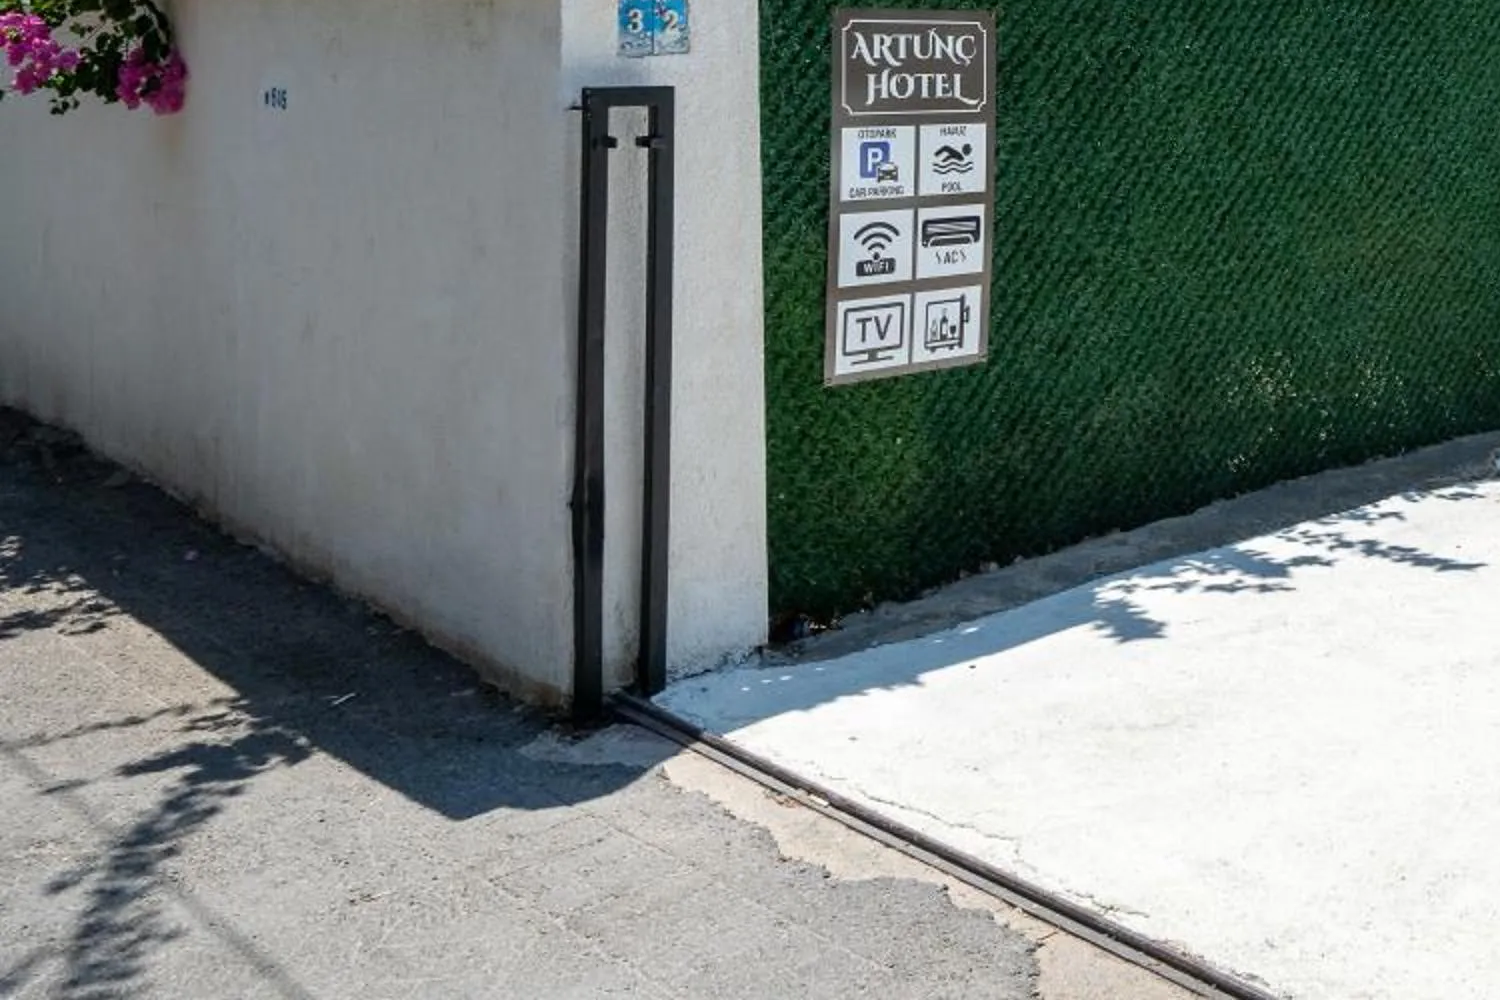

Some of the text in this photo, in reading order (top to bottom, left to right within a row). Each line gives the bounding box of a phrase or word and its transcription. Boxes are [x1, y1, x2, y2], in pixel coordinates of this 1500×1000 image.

[851, 28, 977, 67] ARTUNÇ
[865, 68, 980, 105] HOTEL
[856, 314, 893, 343] TV
